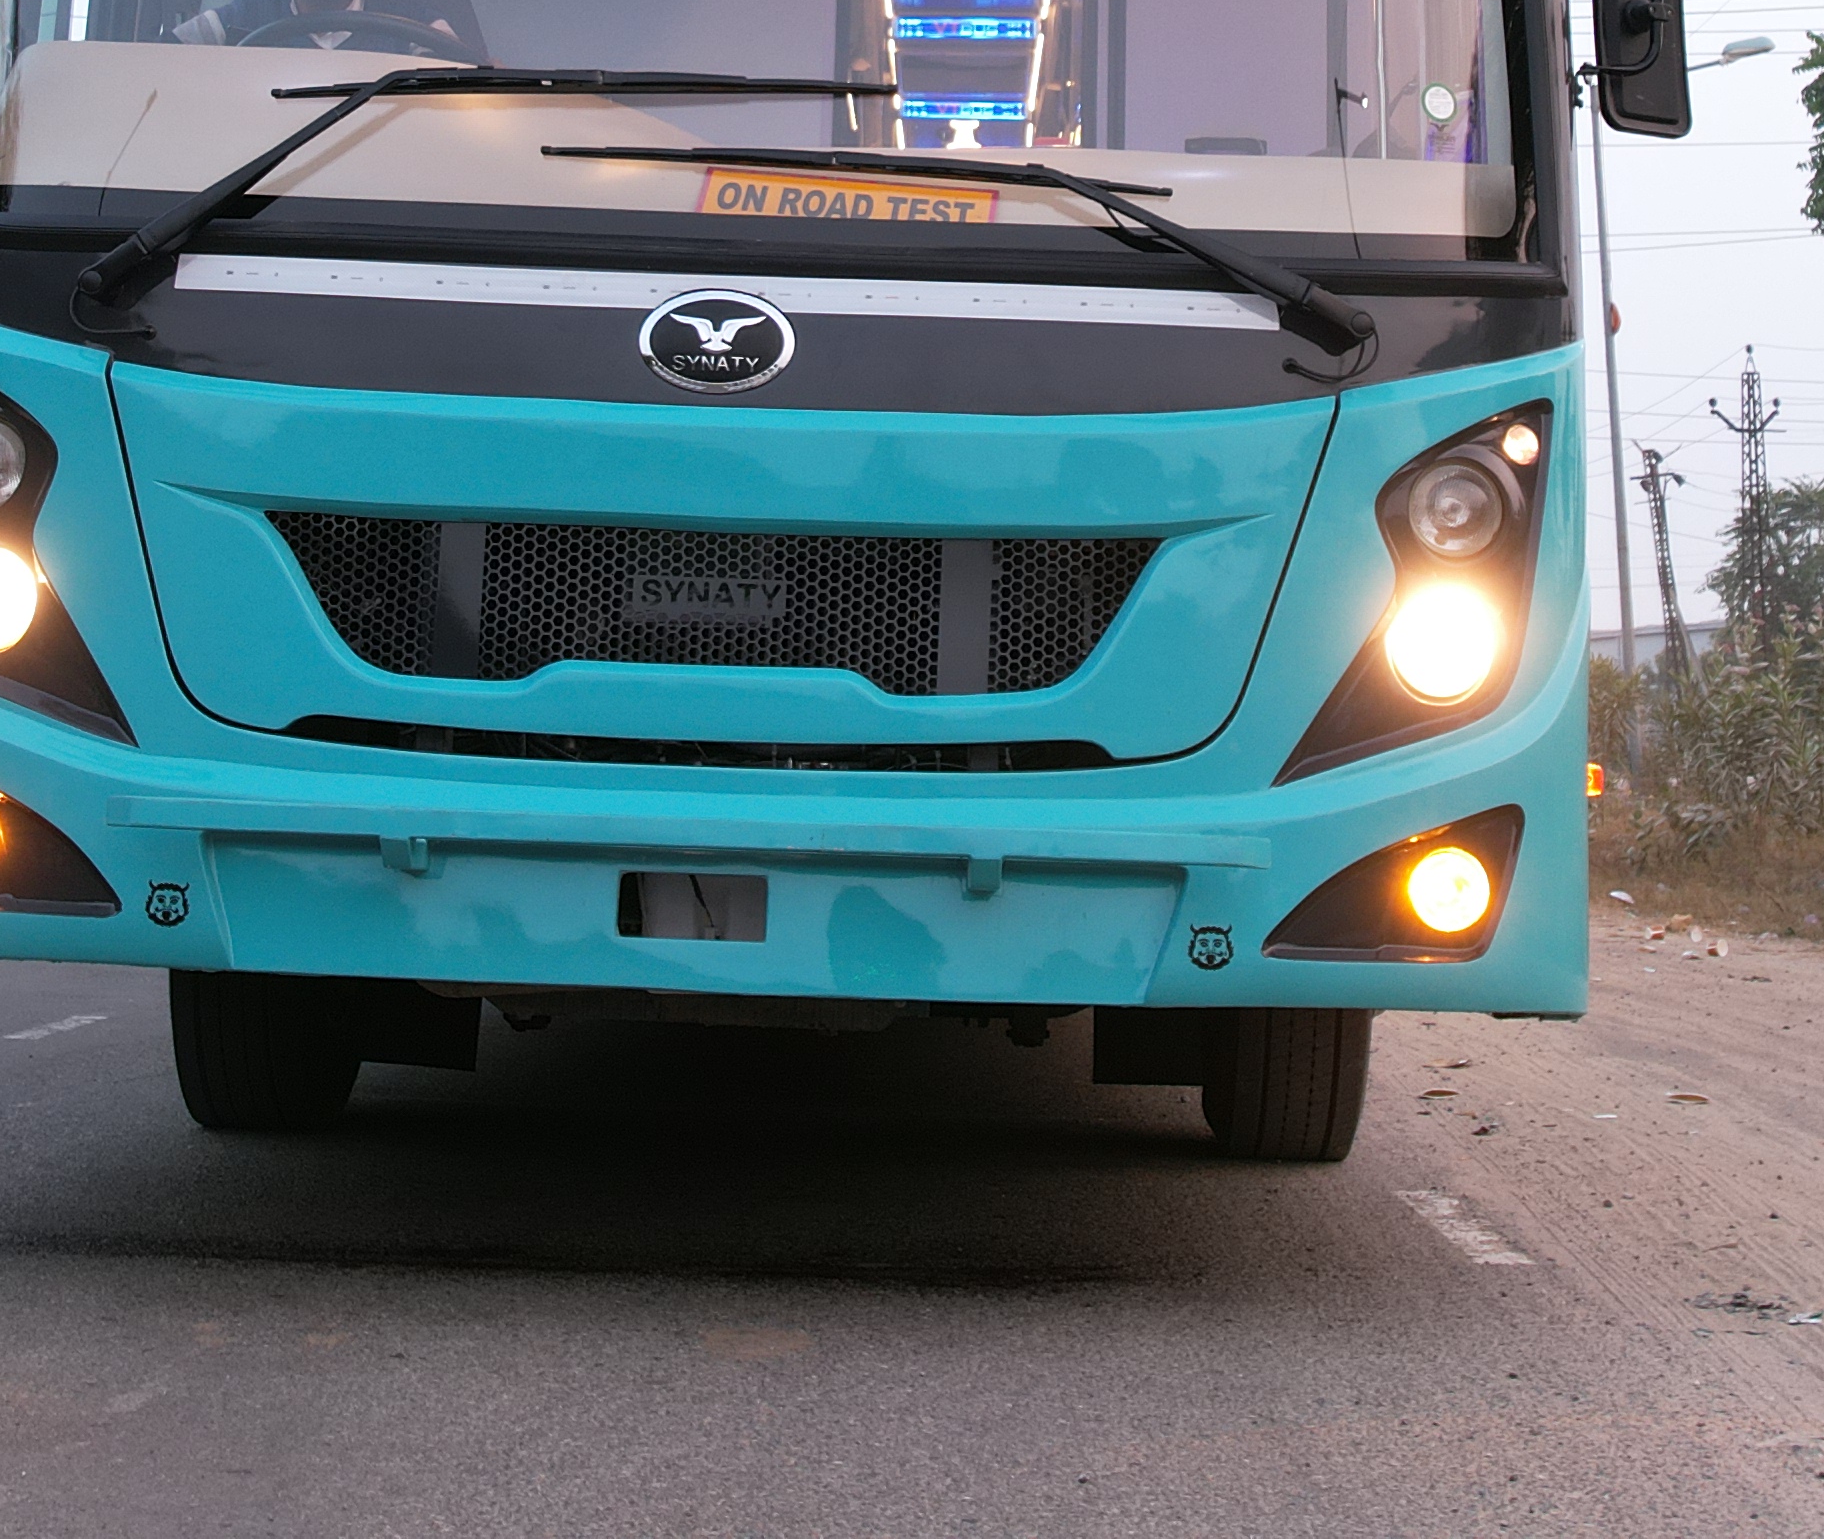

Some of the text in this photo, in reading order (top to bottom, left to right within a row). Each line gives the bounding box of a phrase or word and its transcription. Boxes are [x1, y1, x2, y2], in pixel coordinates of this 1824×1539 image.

[716, 182, 976, 222] ON ROAD TEST
[672, 354, 760, 372] SYNATY
[641, 579, 781, 608] SYNATY
